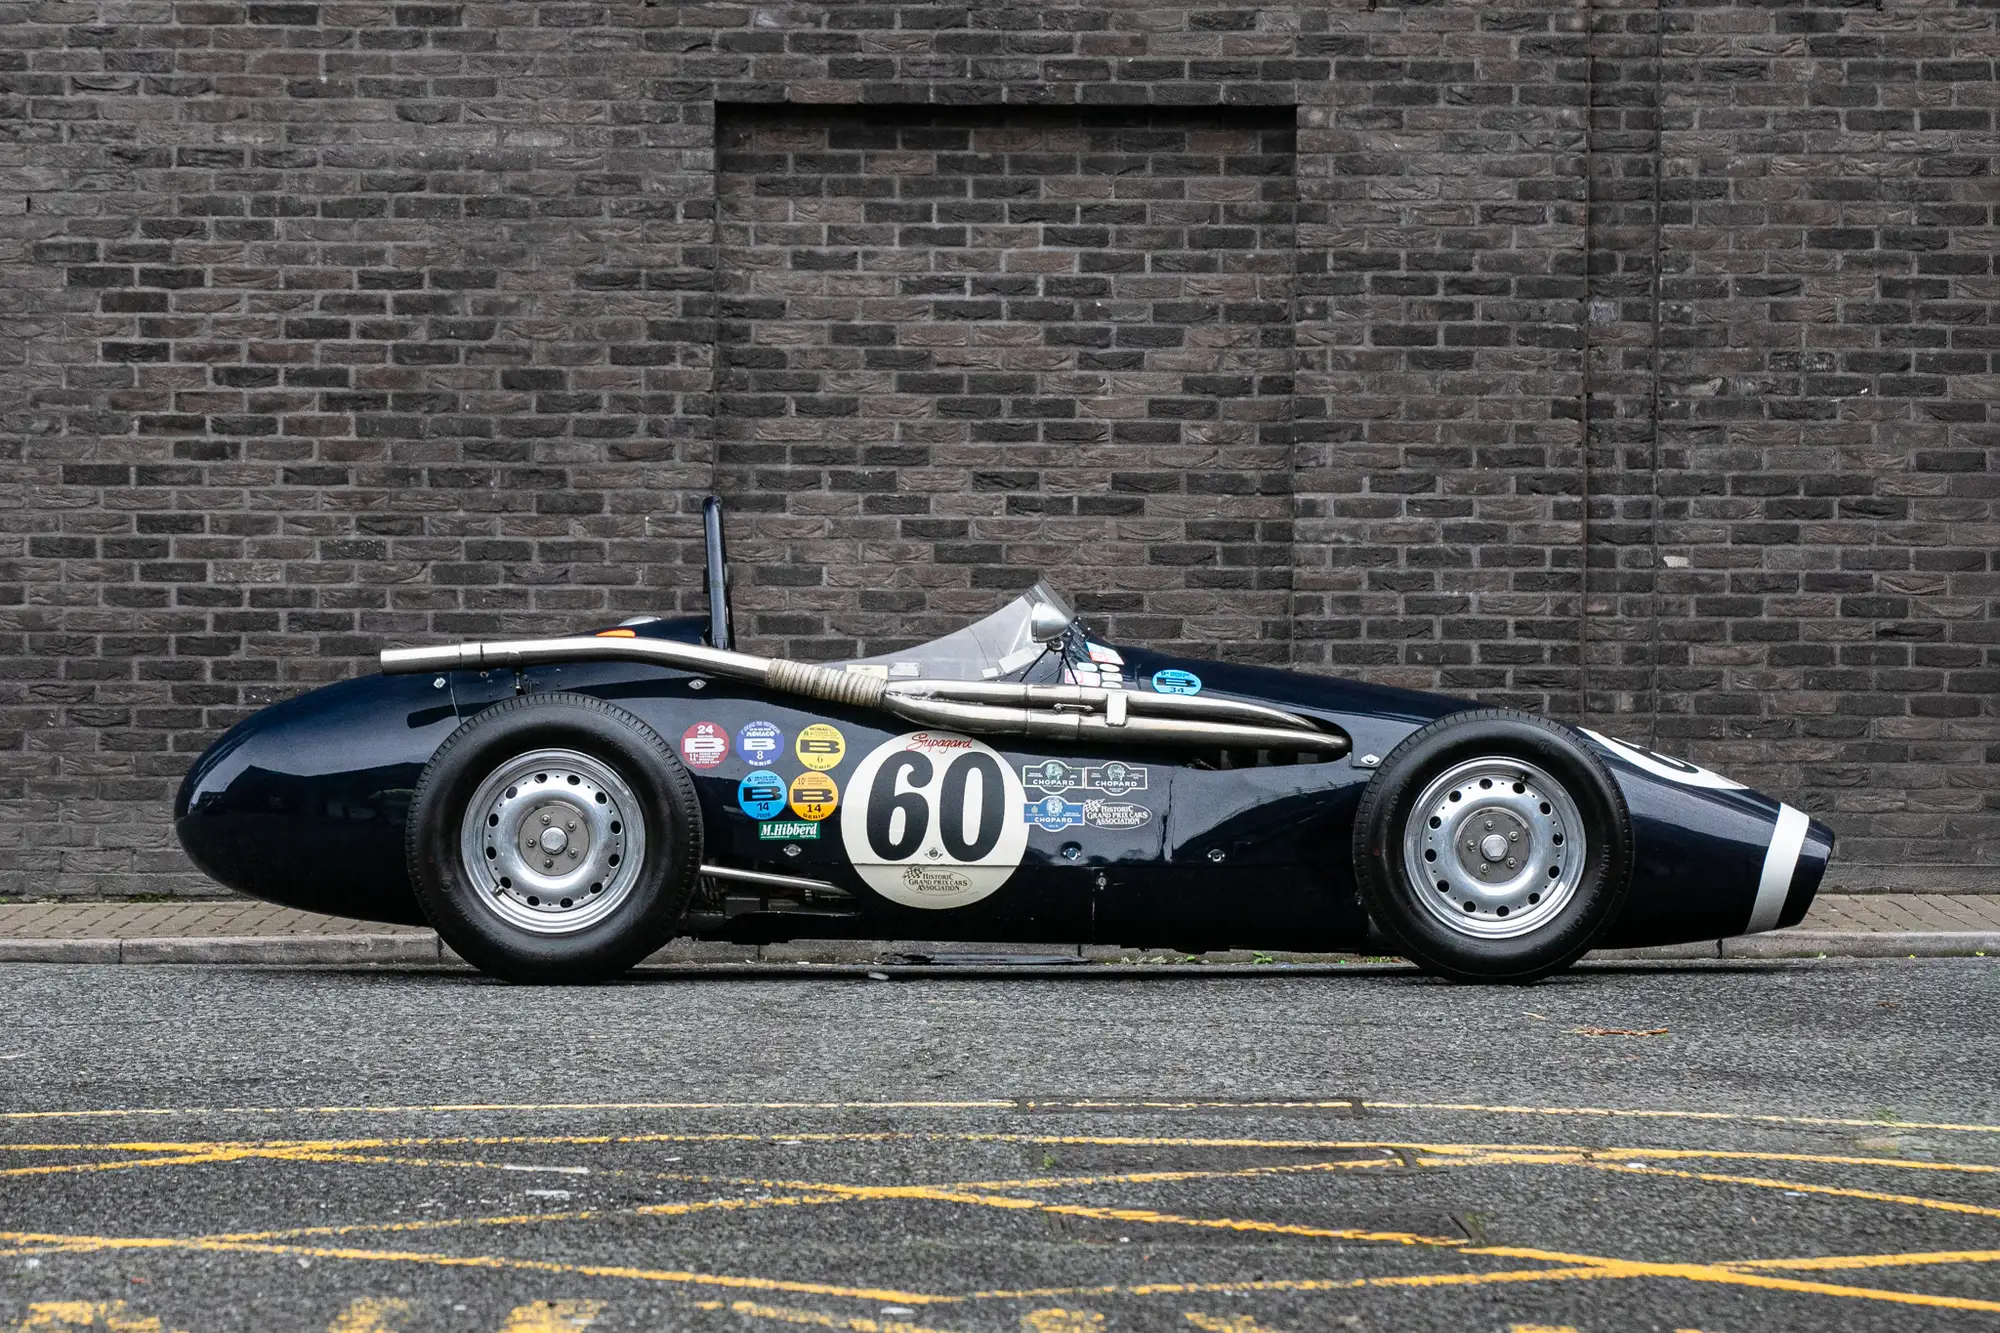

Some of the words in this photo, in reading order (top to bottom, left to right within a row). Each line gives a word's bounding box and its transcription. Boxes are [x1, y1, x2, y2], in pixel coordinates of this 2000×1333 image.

[697, 725, 714, 734] 24
[906, 733, 975, 754] Supagard
[757, 750, 763, 760] 8
[817, 754, 824, 764] 6
[757, 802, 769, 811] 14
[807, 804, 821, 812] 14
[866, 750, 1006, 862] 60
[1096, 818, 1140, 826] ASSOCIATION
[760, 823, 818, 836] M.Hibberd
